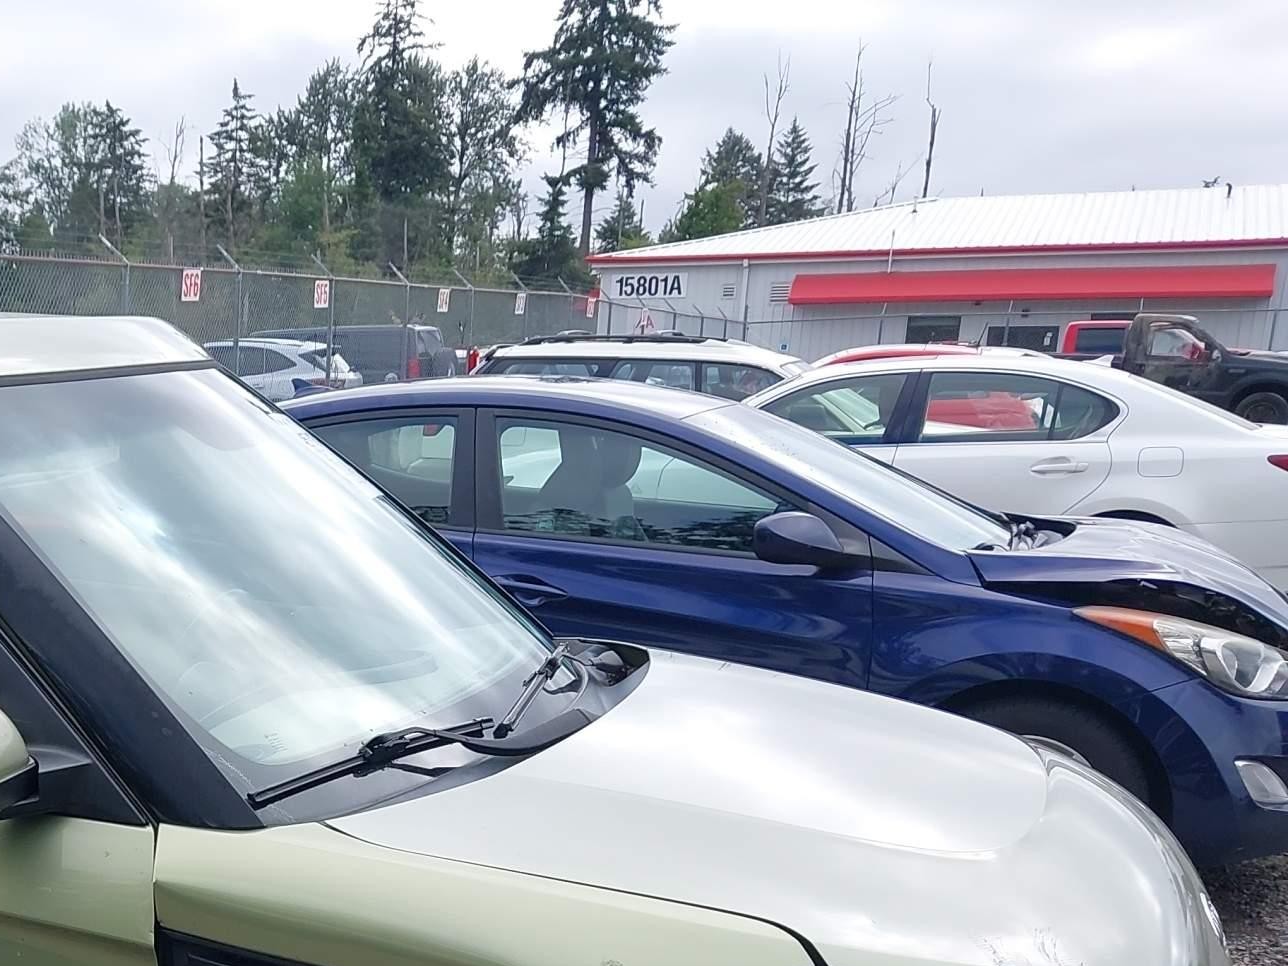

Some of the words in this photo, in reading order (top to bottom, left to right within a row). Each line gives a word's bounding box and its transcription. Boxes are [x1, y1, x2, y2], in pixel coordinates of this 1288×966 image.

[183, 273, 199, 298] SF6
[315, 283, 328, 305] SF5
[615, 275, 682, 297] 15801A
